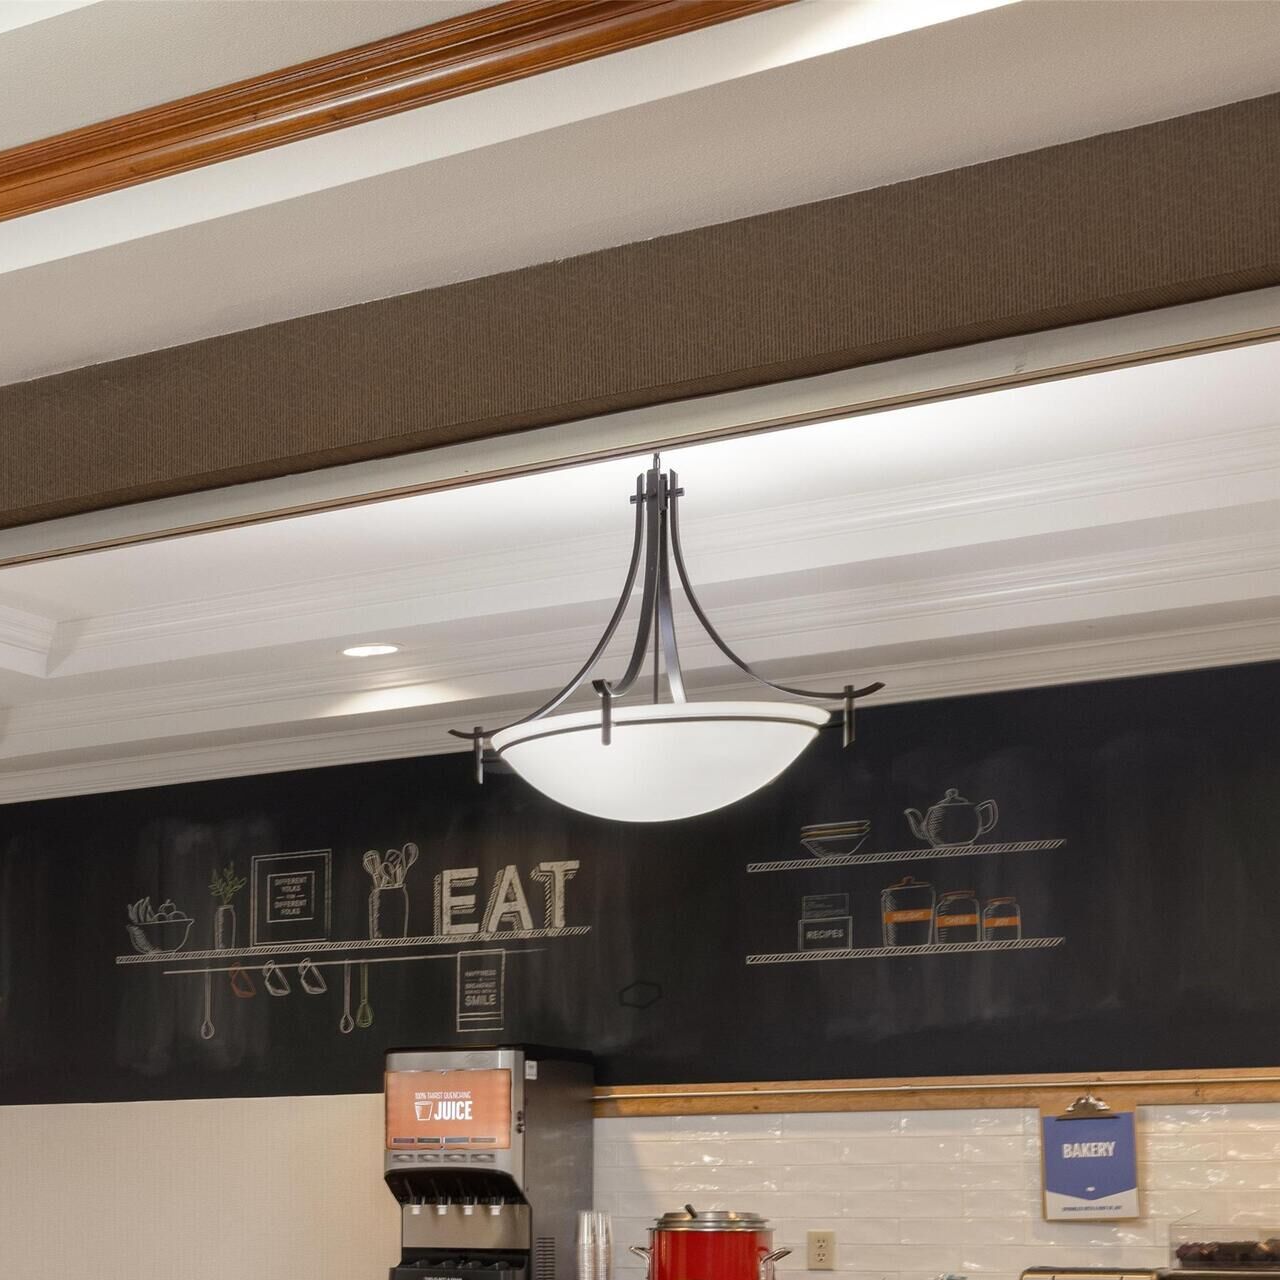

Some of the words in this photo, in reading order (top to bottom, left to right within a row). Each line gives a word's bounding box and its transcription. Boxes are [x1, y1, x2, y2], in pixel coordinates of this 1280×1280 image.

[438, 860, 580, 936] EAT
[806, 928, 844, 940] RECIPES
[464, 994, 496, 1006] SMILE
[433, 1101, 474, 1120] JUICE
[1062, 1141, 1117, 1158] BAKERY
